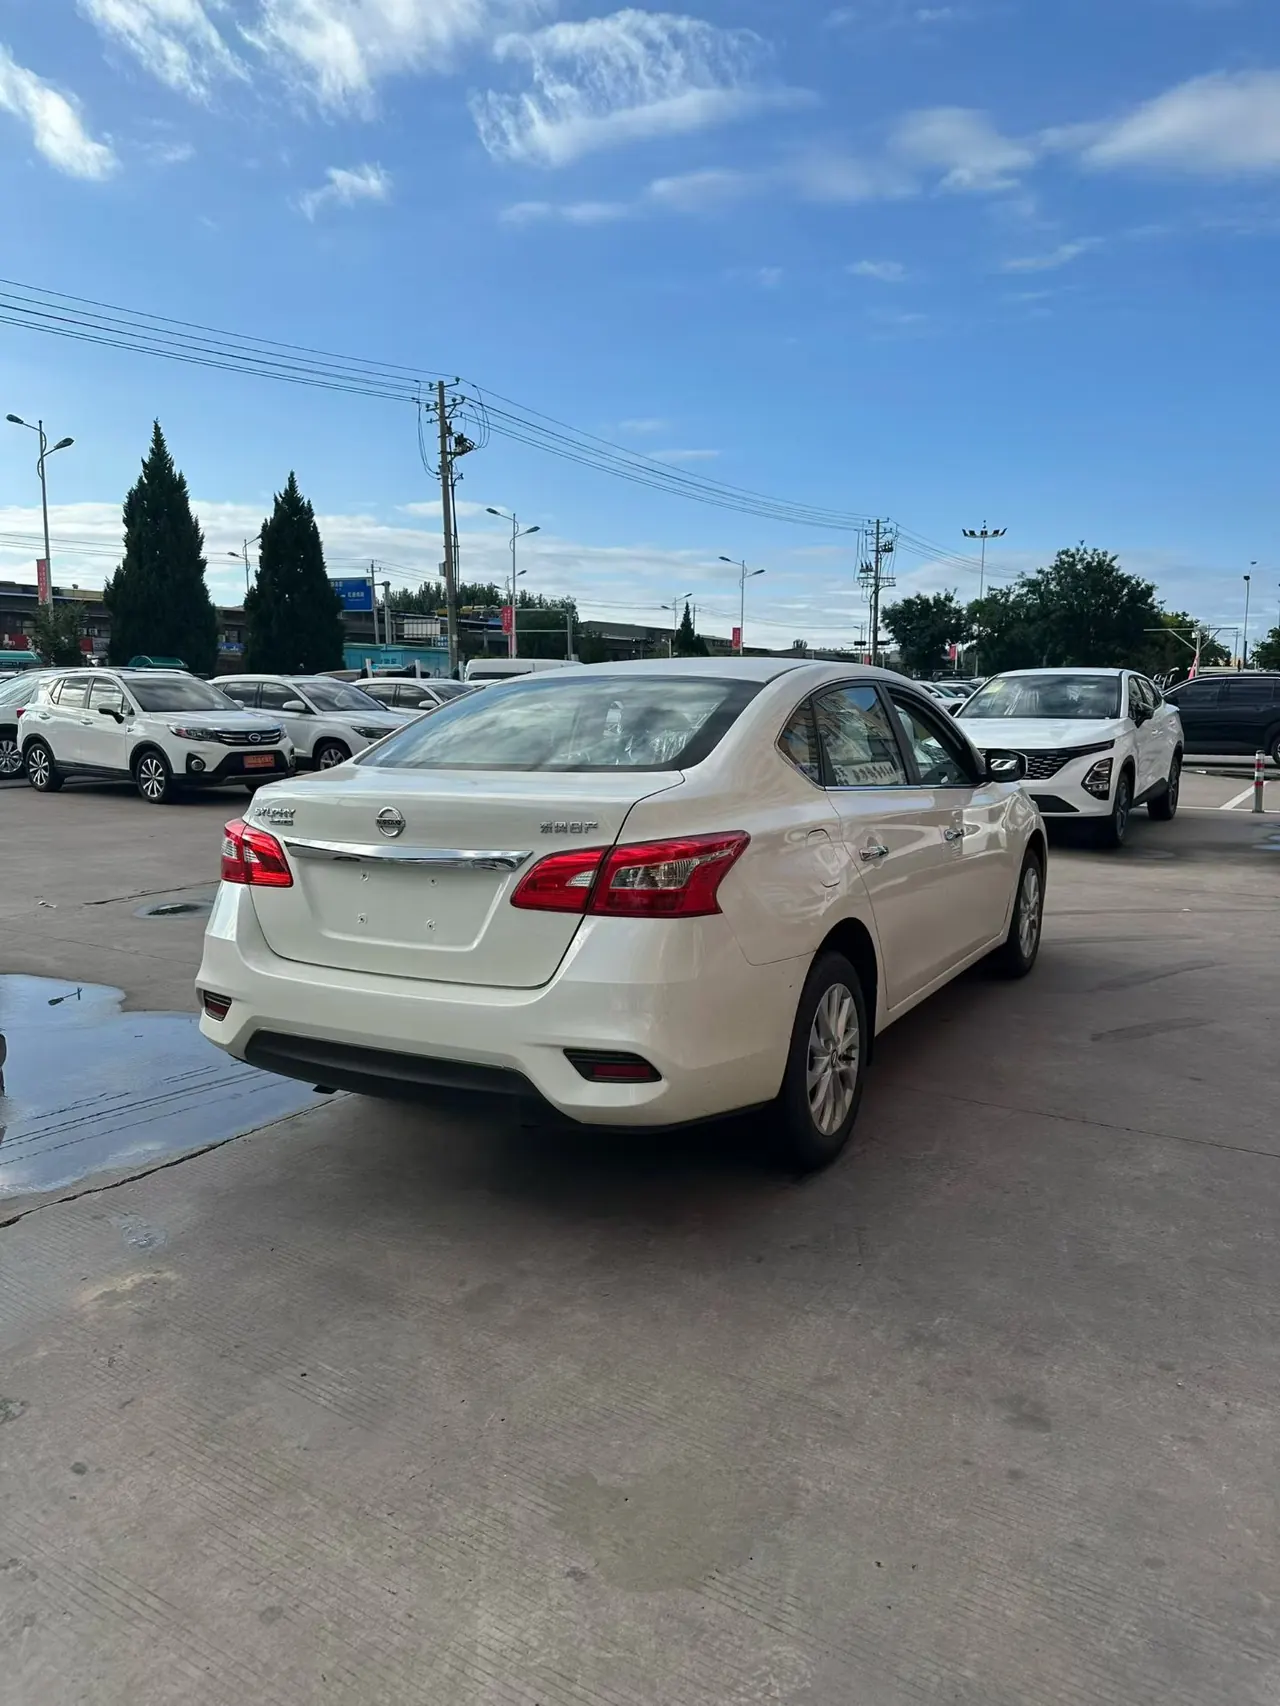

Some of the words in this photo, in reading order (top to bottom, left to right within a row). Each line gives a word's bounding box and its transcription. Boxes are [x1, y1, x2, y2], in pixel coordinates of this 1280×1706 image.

[254, 807, 296, 819] SYLPHY
[540, 821, 598, 834] 东风日产
